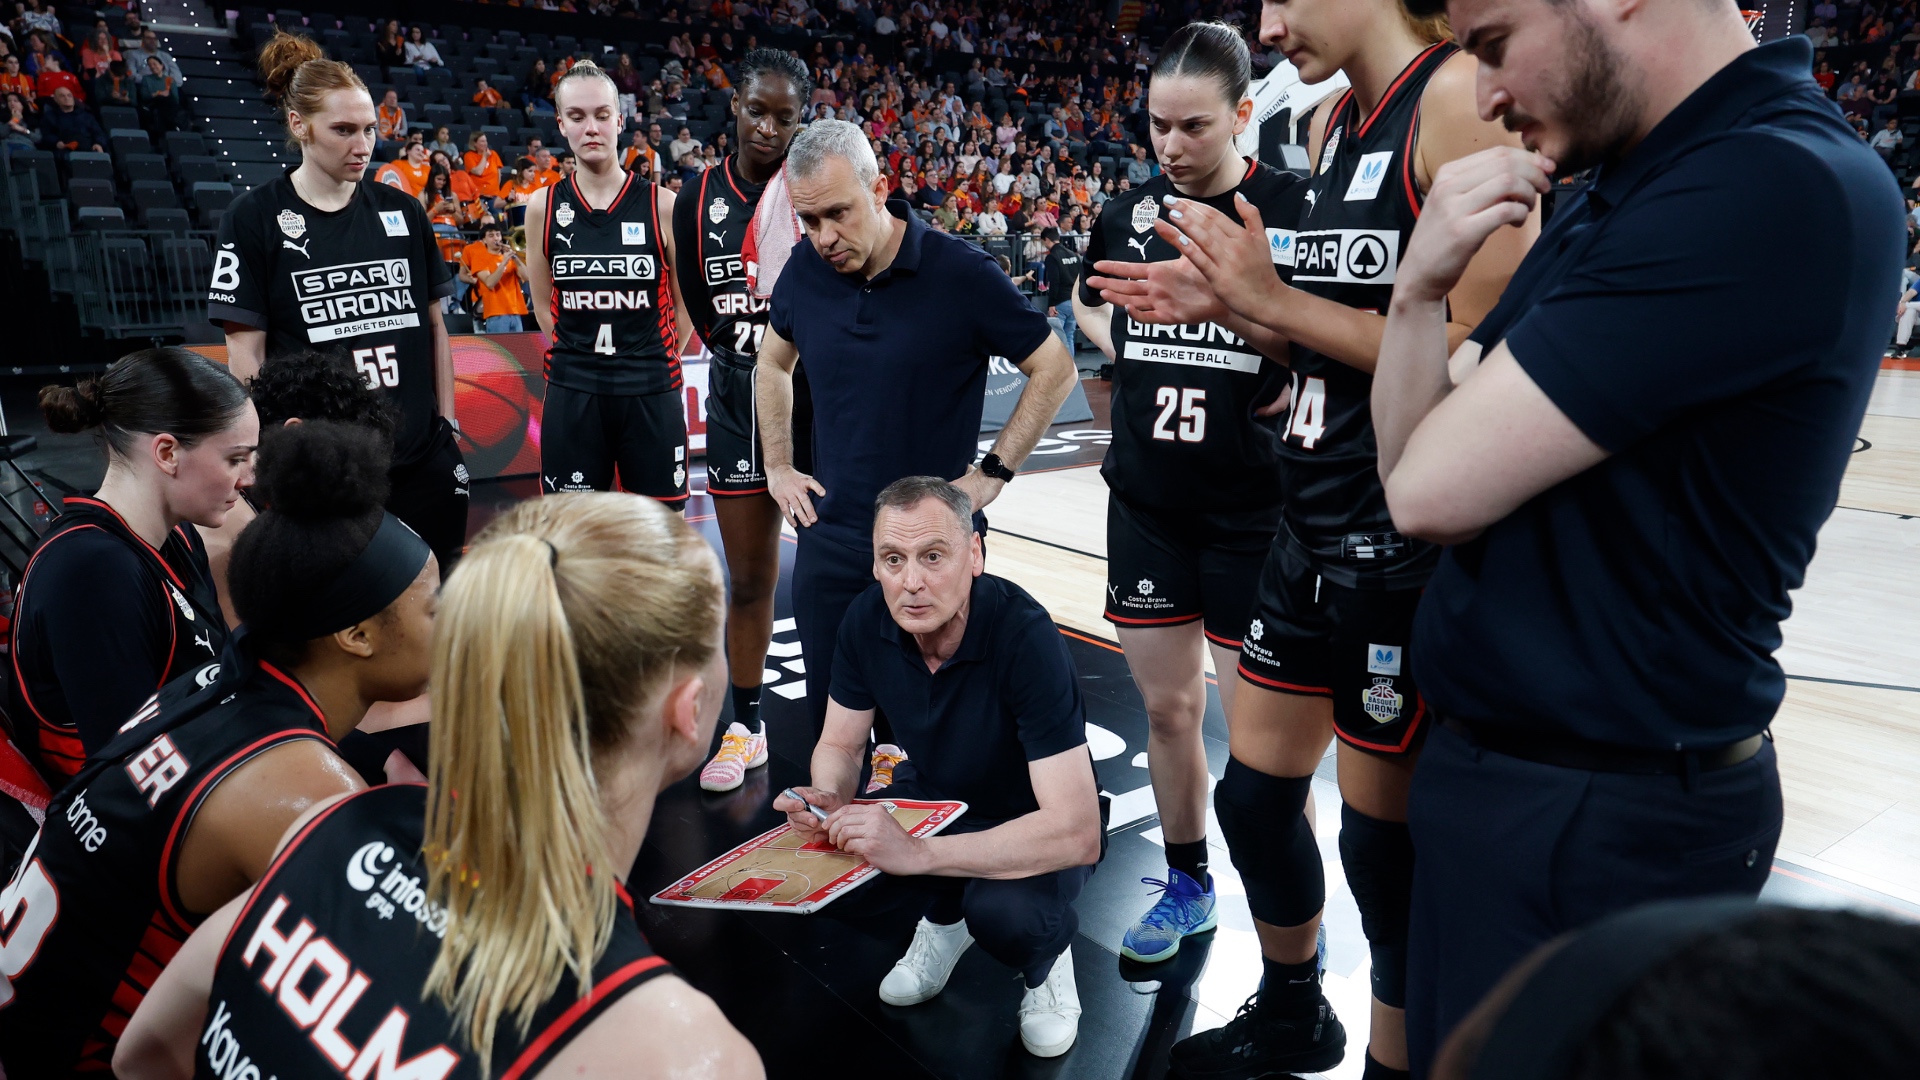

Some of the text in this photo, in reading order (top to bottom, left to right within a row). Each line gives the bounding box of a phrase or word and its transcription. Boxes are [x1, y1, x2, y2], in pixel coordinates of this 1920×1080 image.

[1294, 240, 1339, 270] PAR
[555, 259, 626, 274] SPAR
[709, 260, 743, 279] SP
[302, 266, 388, 293] SPAR
[300, 289, 416, 324] GIRONA
[561, 290, 650, 310] GIRONA
[334, 318, 404, 336] BASKETBALL
[594, 323, 616, 356] 4
[733, 321, 766, 356] 21
[1142, 347, 1231, 366] BASKETBALL
[353, 344, 400, 391] 55
[994, 377, 1021, 395] VENDING
[1153, 386, 1206, 443] 25
[1122, 600, 1143, 609] Pirineu
[1128, 595, 1146, 603] Costa
[1253, 643, 1273, 657] Brava
[1256, 653, 1281, 667] Girona
[1365, 703, 1399, 716] GIRONA
[911, 823, 935, 838] ONA
[241, 893, 461, 1080] HOLM
